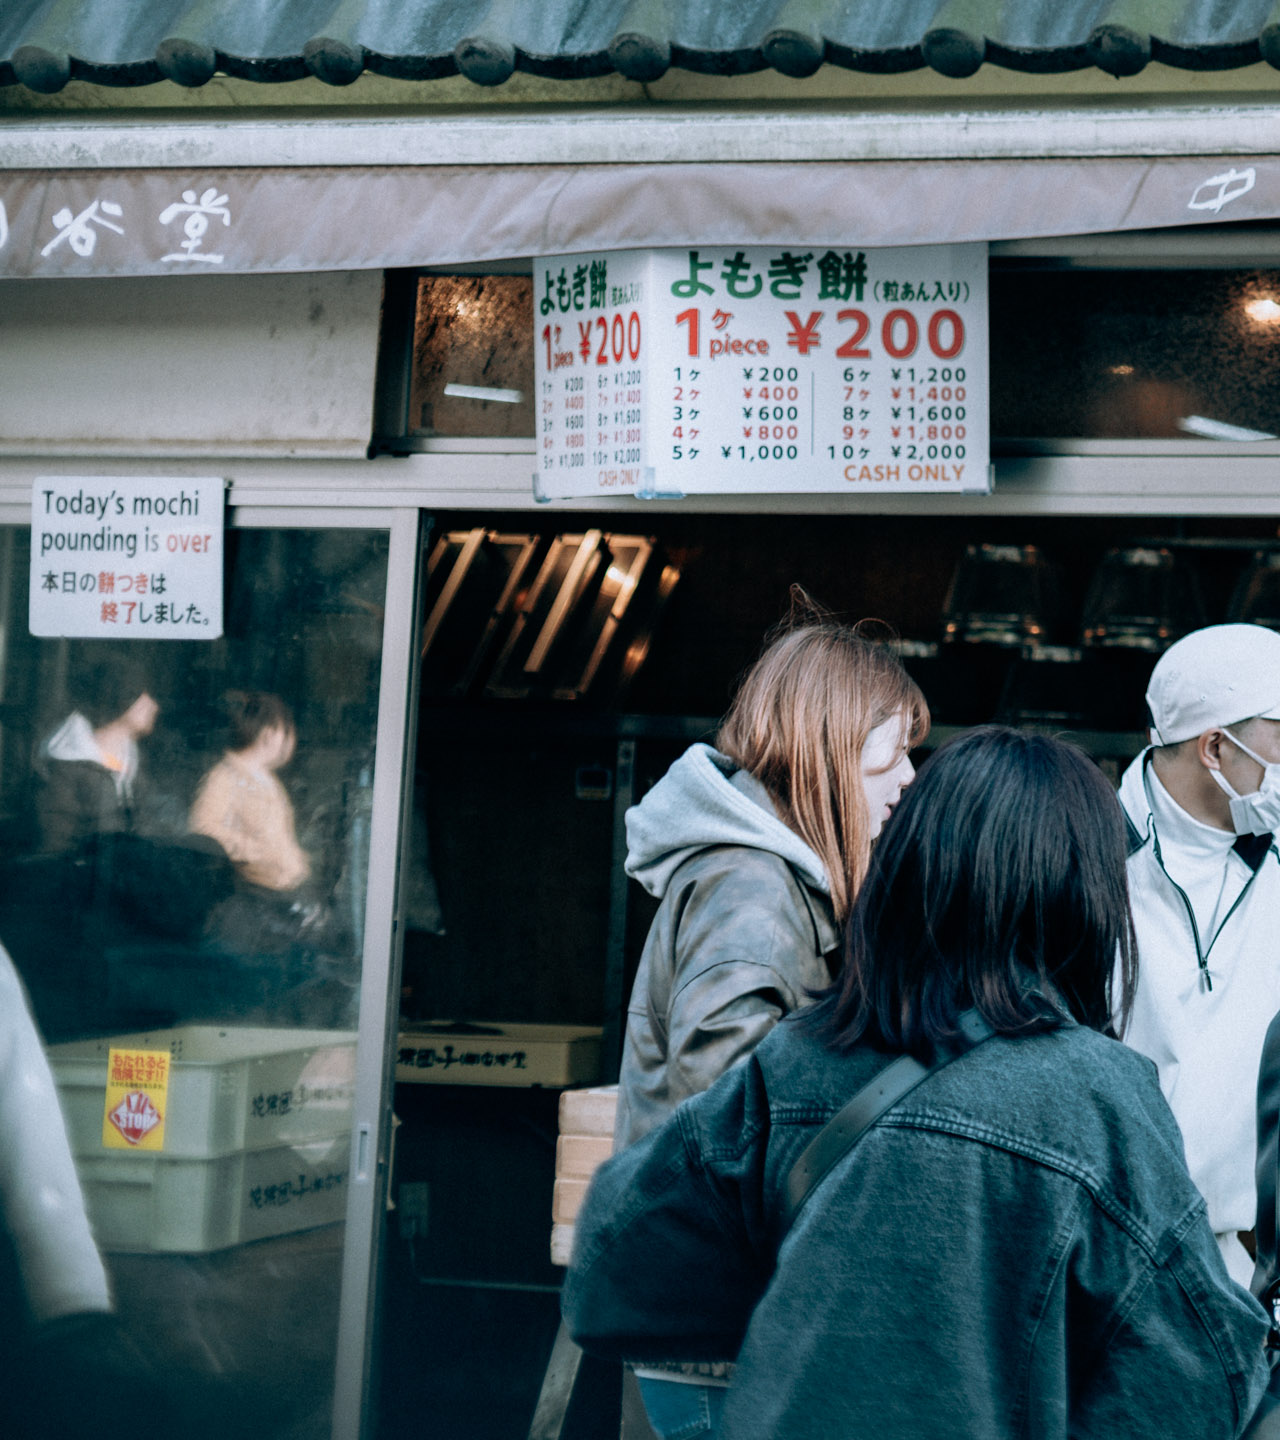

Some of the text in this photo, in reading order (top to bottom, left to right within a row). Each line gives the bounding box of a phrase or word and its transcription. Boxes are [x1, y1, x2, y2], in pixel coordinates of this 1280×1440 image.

[0, 187, 232, 264] 谷堂
[540, 259, 607, 316] よもぎ餅
[670, 250, 868, 302] よもぎ餅
[578, 311, 641, 366] ¥200
[709, 332, 769, 358] piece
[784, 308, 966, 360] ¥200
[743, 367, 799, 381] ¥200
[891, 367, 966, 384] ¥1,200
[743, 387, 799, 400] ¥400
[891, 387, 966, 403] ¥1,400
[743, 407, 799, 420] ¥600
[891, 407, 966, 423] ¥1,600
[743, 426, 799, 439] ¥800
[891, 426, 966, 442] ¥1,800
[721, 445, 799, 462] ¥1,000
[891, 445, 966, 462] ¥2,000
[844, 464, 966, 481] CASH ONLY
[42, 489, 199, 521] Today's mochi
[41, 526, 212, 558] pounding is over
